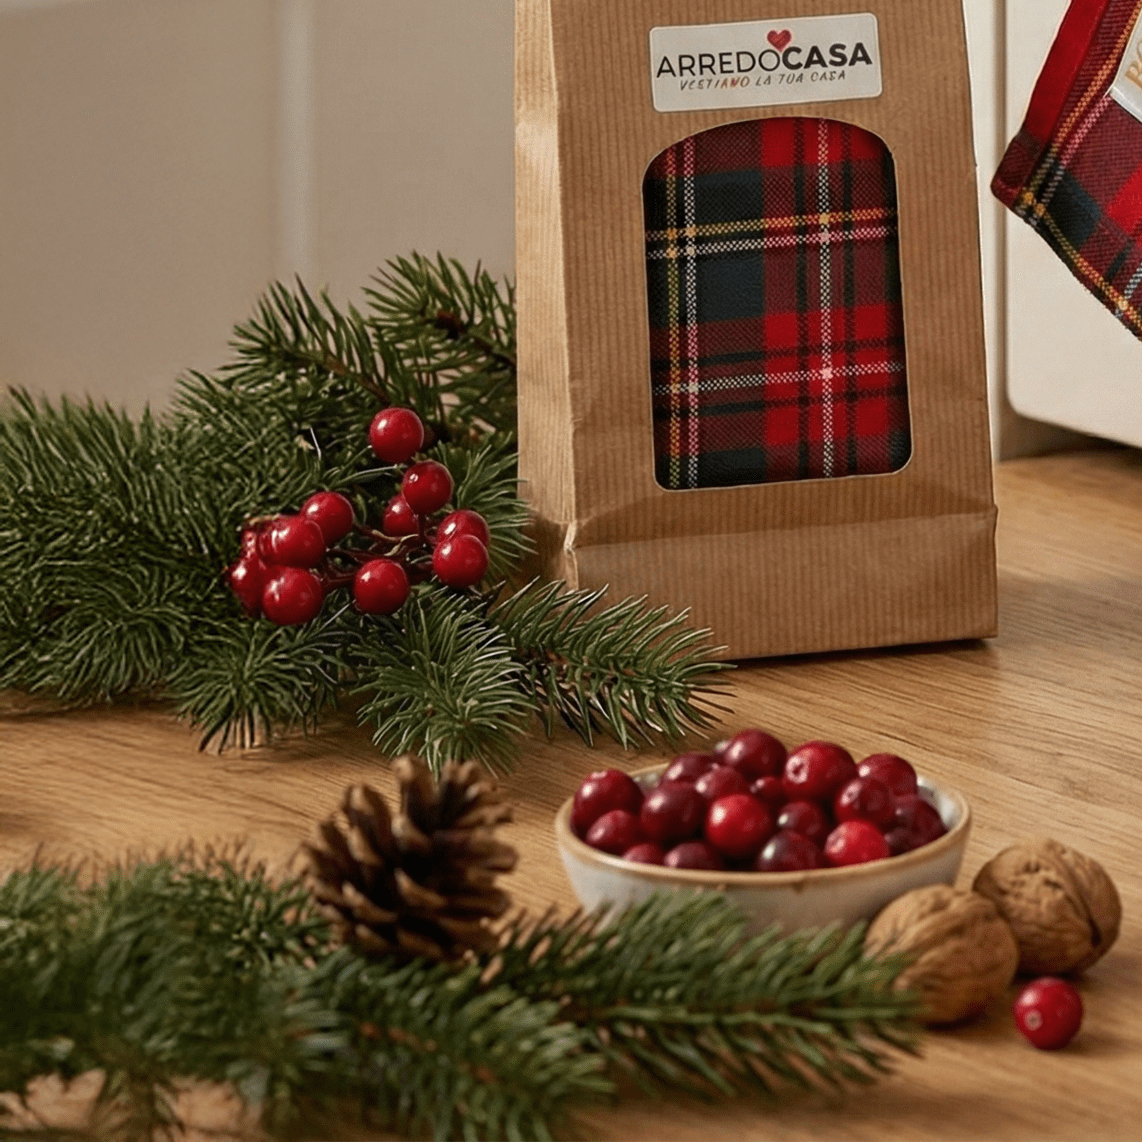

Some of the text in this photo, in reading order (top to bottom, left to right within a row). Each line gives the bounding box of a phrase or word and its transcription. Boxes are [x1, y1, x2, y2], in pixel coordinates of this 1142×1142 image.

[656, 42, 873, 78] ARREDOCASA
[755, 74, 771, 86] LA
[779, 73, 803, 85] TUA
[811, 69, 846, 82] CASA
